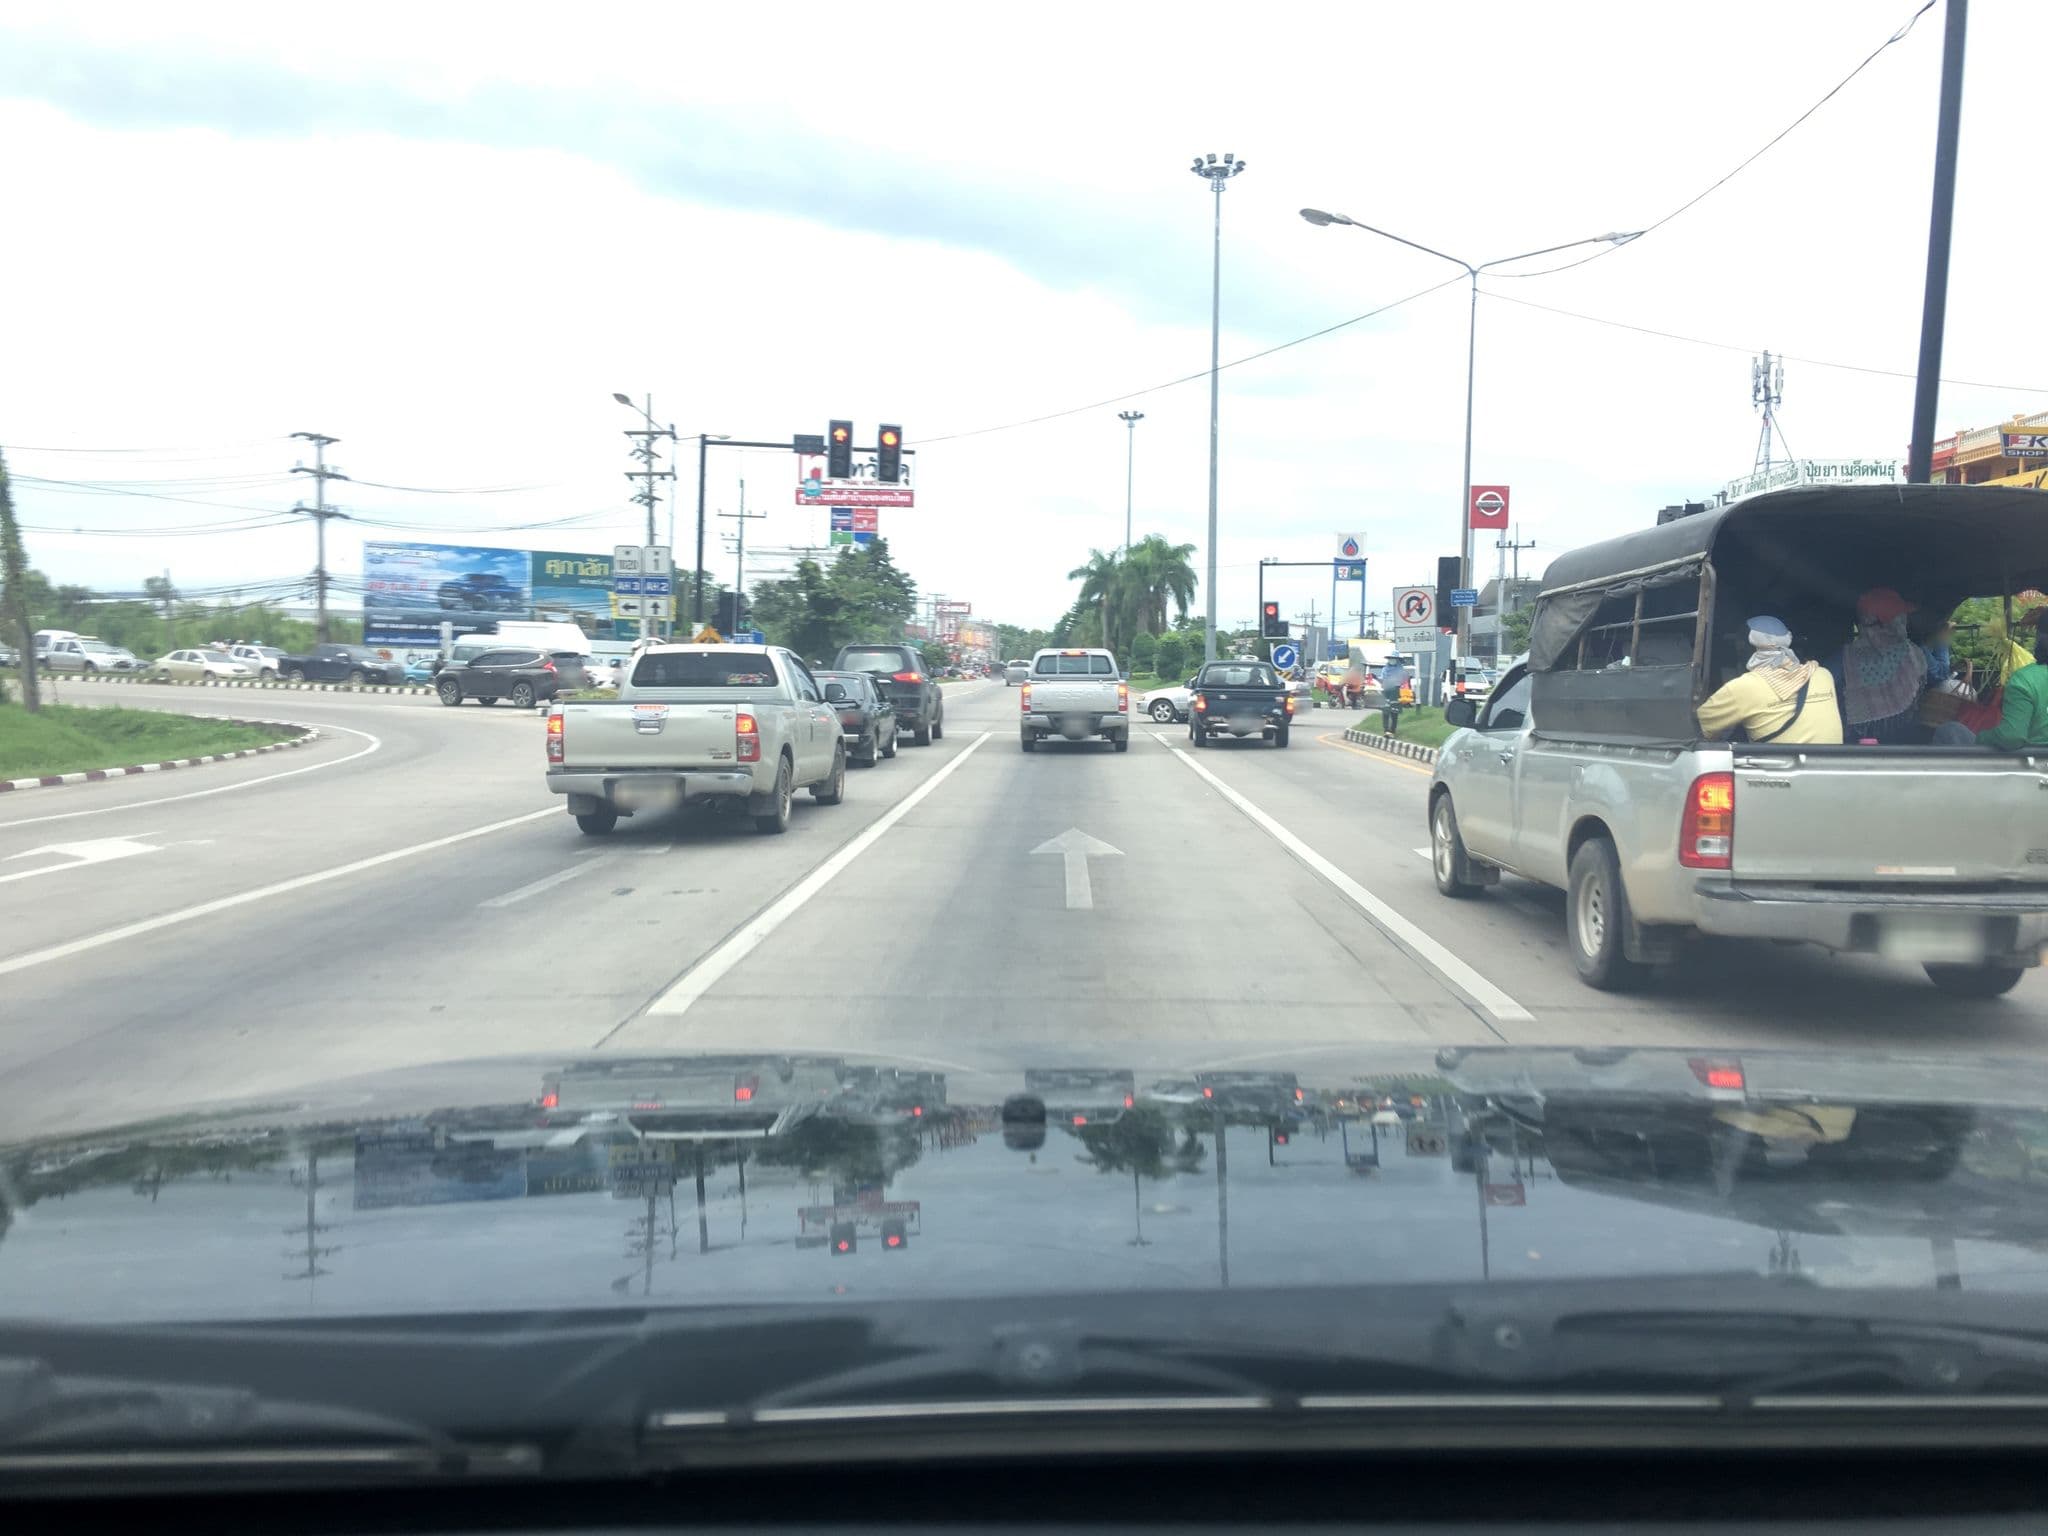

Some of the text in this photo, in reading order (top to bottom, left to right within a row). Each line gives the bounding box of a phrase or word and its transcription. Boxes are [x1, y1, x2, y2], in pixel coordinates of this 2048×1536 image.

[1840, 460, 1896, 482] เมล็ดพันธุ์
